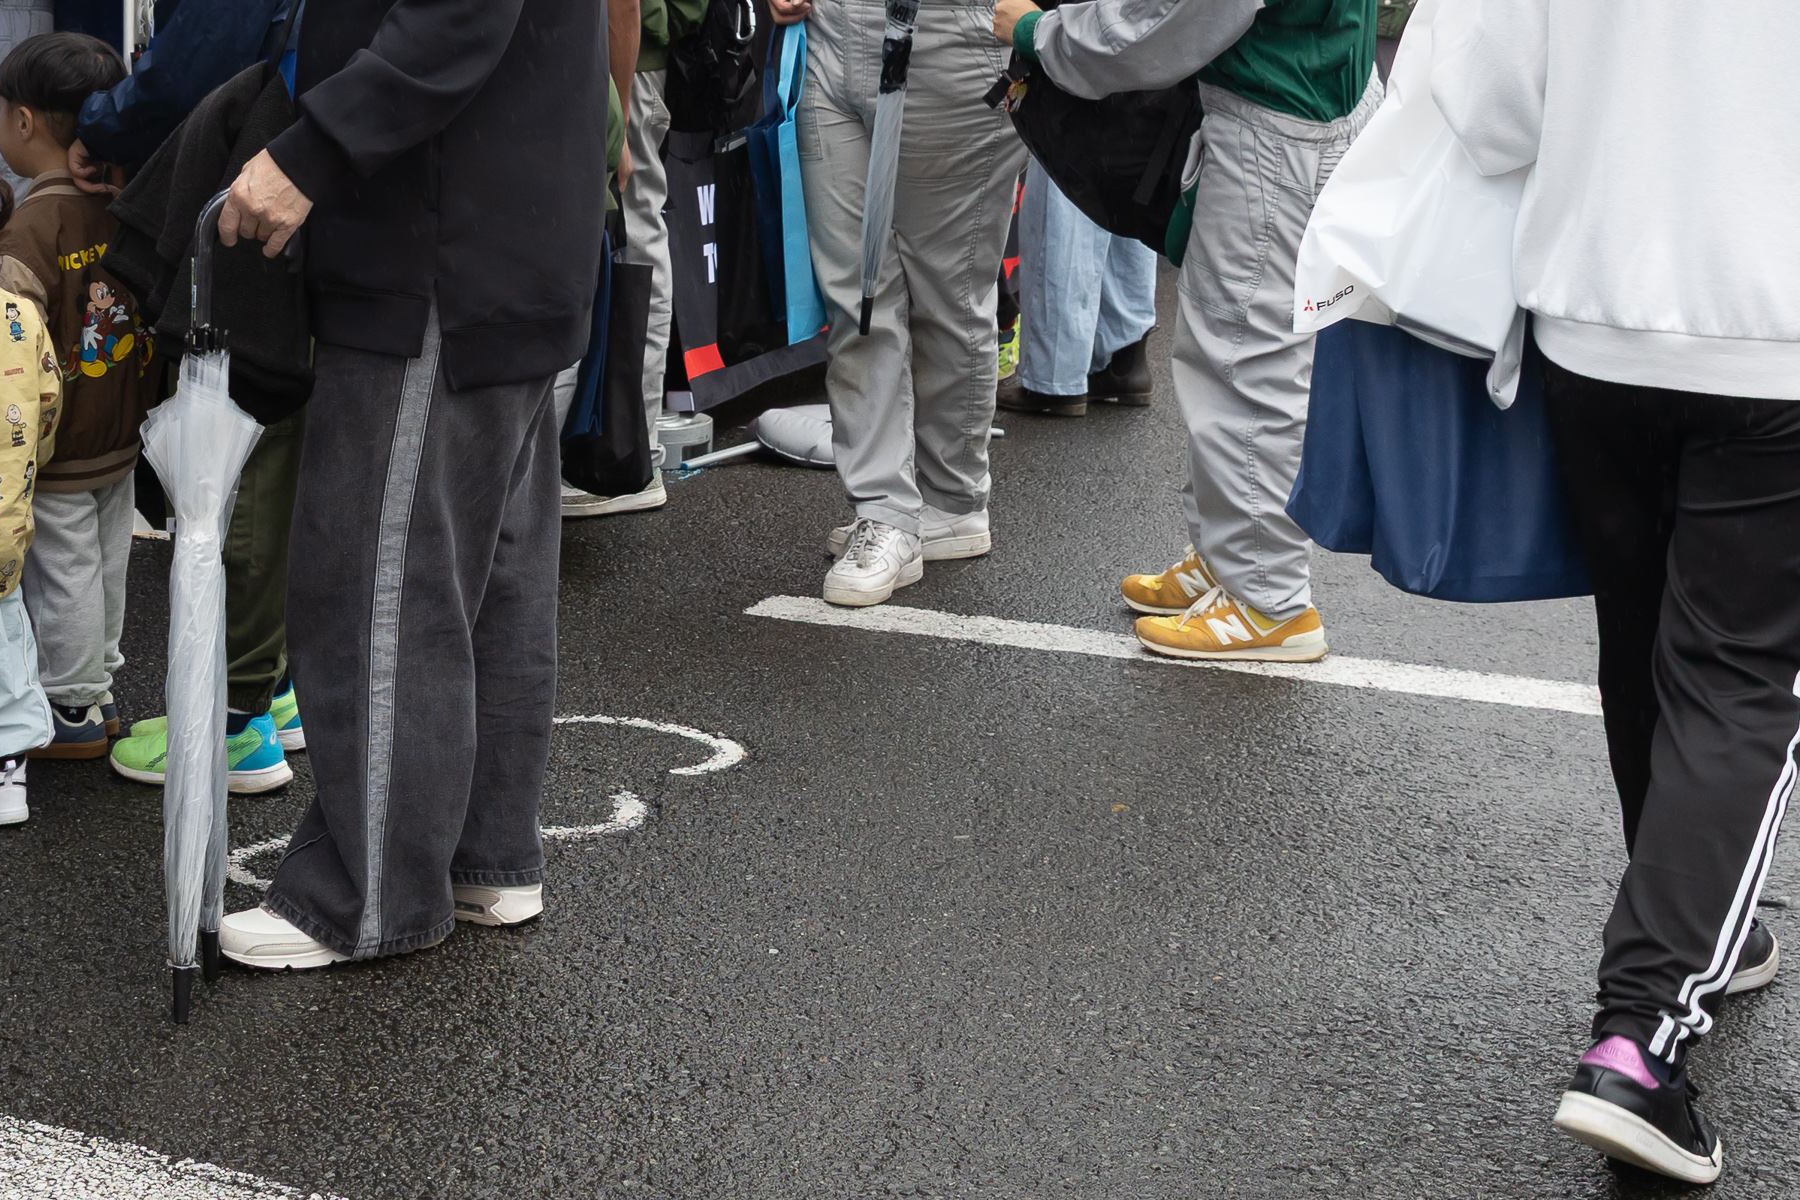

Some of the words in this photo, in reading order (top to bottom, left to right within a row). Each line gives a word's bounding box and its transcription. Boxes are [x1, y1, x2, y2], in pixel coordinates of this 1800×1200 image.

[1316, 285, 1354, 311] FUSO
[1174, 567, 1212, 598] N
[1205, 613, 1254, 646] N
